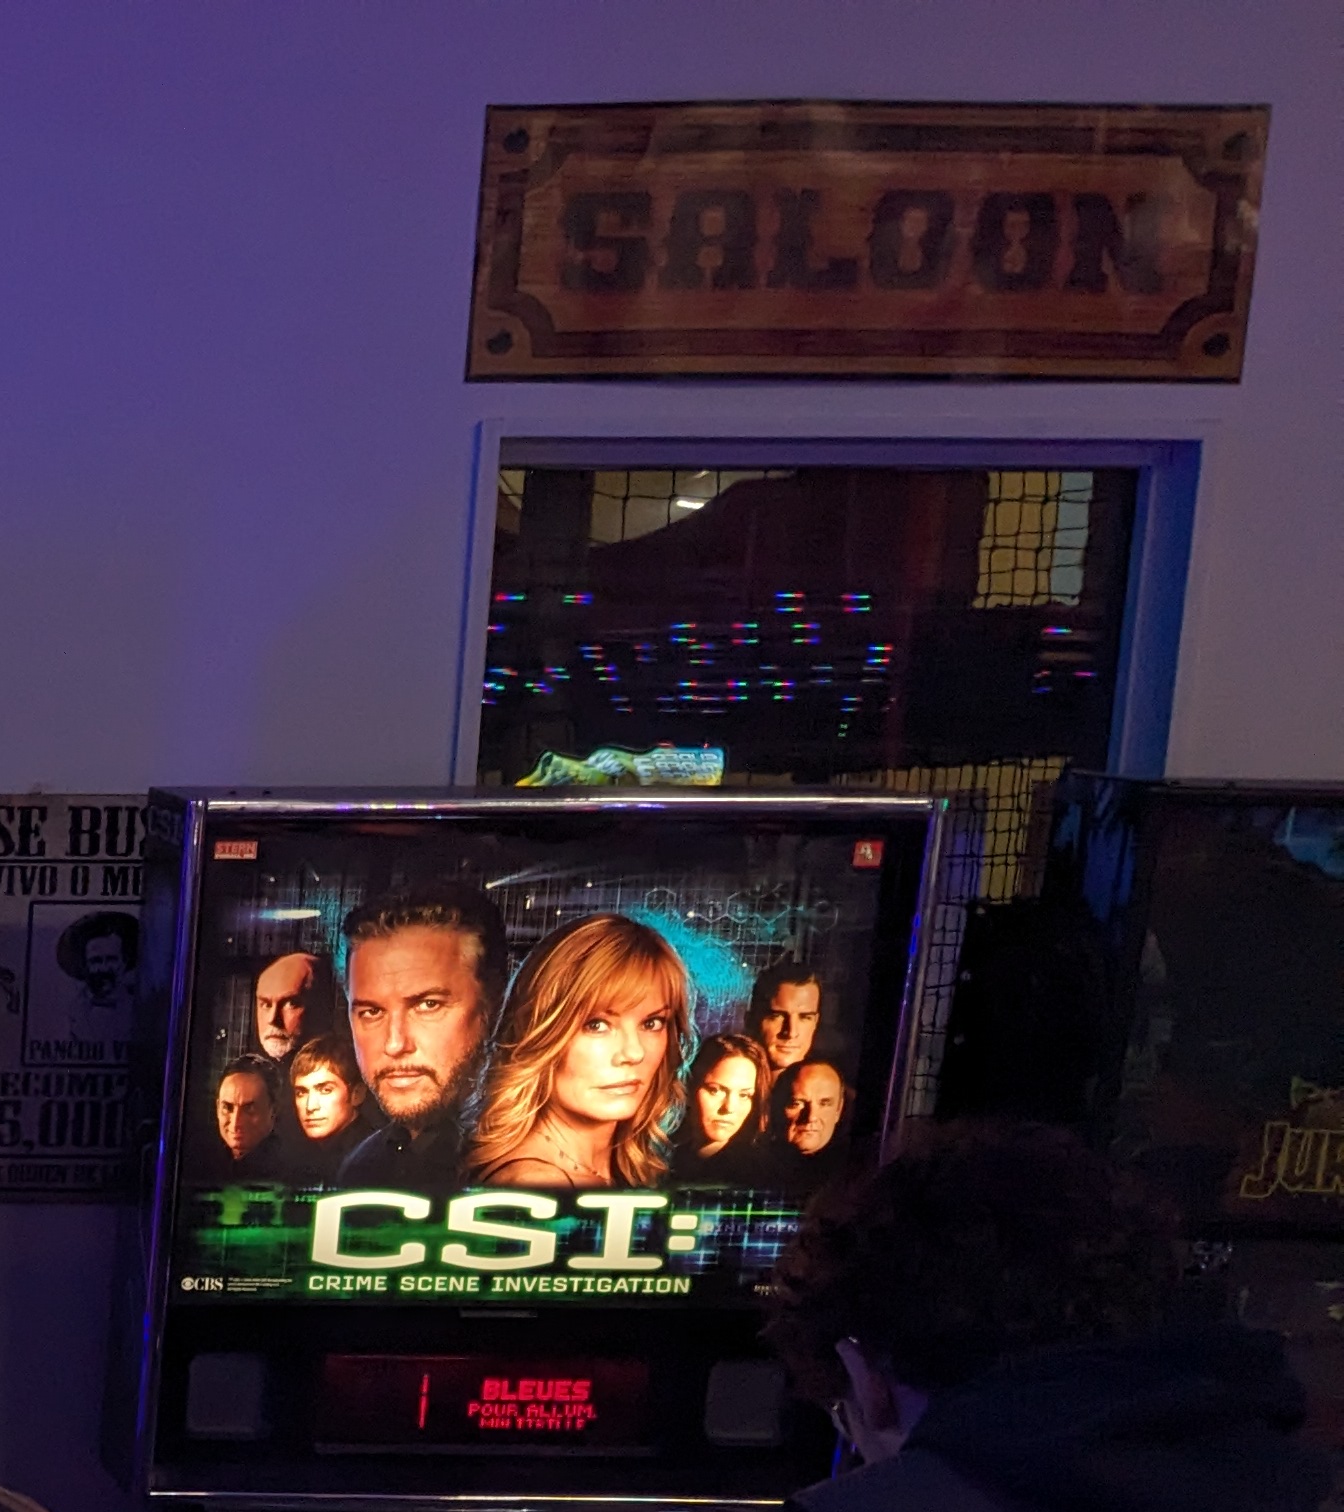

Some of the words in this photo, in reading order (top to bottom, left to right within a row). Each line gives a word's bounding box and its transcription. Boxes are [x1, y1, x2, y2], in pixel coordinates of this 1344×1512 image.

[560, 189, 1168, 293] SALOON
[70, 865, 90, 896] O
[311, 1191, 699, 1271] CSI:
[194, 1277, 224, 1292] CBS
[308, 1274, 388, 1293] CRIME
[399, 1274, 481, 1294] SCENE
[491, 1275, 691, 1295] INVESTIGATION
[483, 1379, 591, 1401] BLEUES
